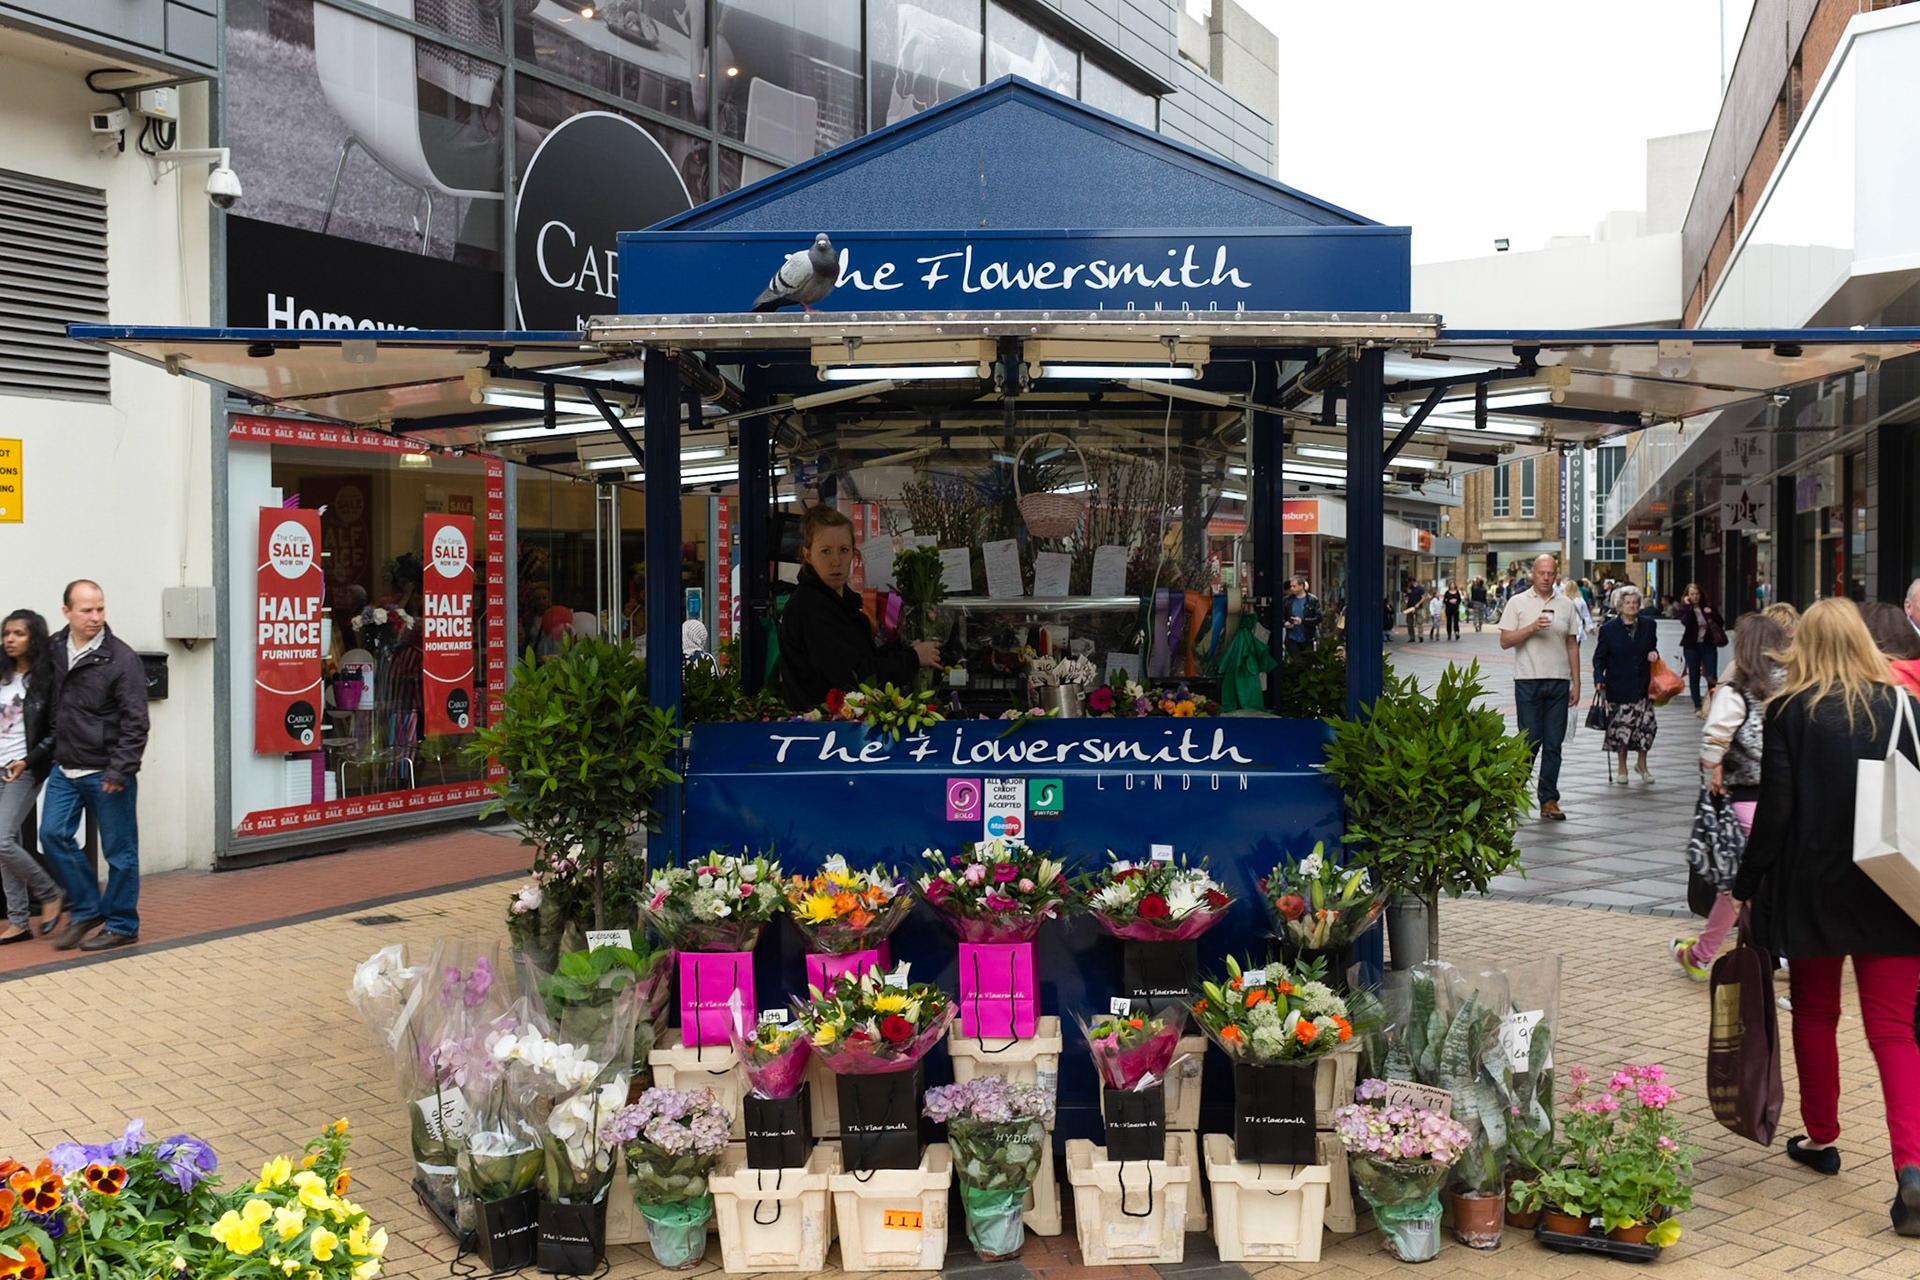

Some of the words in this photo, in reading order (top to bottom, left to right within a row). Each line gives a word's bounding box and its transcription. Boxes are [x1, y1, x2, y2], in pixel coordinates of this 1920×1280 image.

[806, 247, 903, 291] he
[917, 245, 1252, 293] Flowersmith
[252, 427, 270, 436] SALE
[275, 429, 293, 438] SALE
[298, 431, 316, 440] SALE
[320, 433, 337, 442] SALE
[362, 437, 379, 446] SALE
[383, 439, 398, 448] SALE
[488, 491, 503, 499] SALE
[489, 512, 503, 520] SALE
[289, 534, 307, 543] Cargo
[323, 528, 361, 547] ALF
[273, 543, 310, 557] SALE
[435, 546, 464, 559] SALE
[259, 597, 320, 621] HALF
[425, 594, 472, 616] HALF
[259, 622, 320, 645] PRICE
[425, 617, 472, 638] PRICE
[262, 649, 317, 660] FURNITURE
[425, 641, 472, 651] HOMEWARES
[770, 731, 890, 763] The
[906, 728, 1252, 765] Flowersmith
[491, 767, 505, 775] SALE
[1097, 773, 1248, 790] LONDON
[257, 819, 276, 829] SALE
[281, 815, 299, 825] SALE
[303, 812, 321, 822] SALE
[325, 809, 343, 819] SALE
[346, 806, 363, 815] SALE
[368, 803, 384, 812] SALE
[388, 800, 403, 809] SALE
[409, 797, 424, 806] SALE
[428, 794, 443, 803] SALE
[447, 792, 462, 800] SALE
[465, 789, 480, 797] SALE
[991, 822, 1019, 830] Maestro
